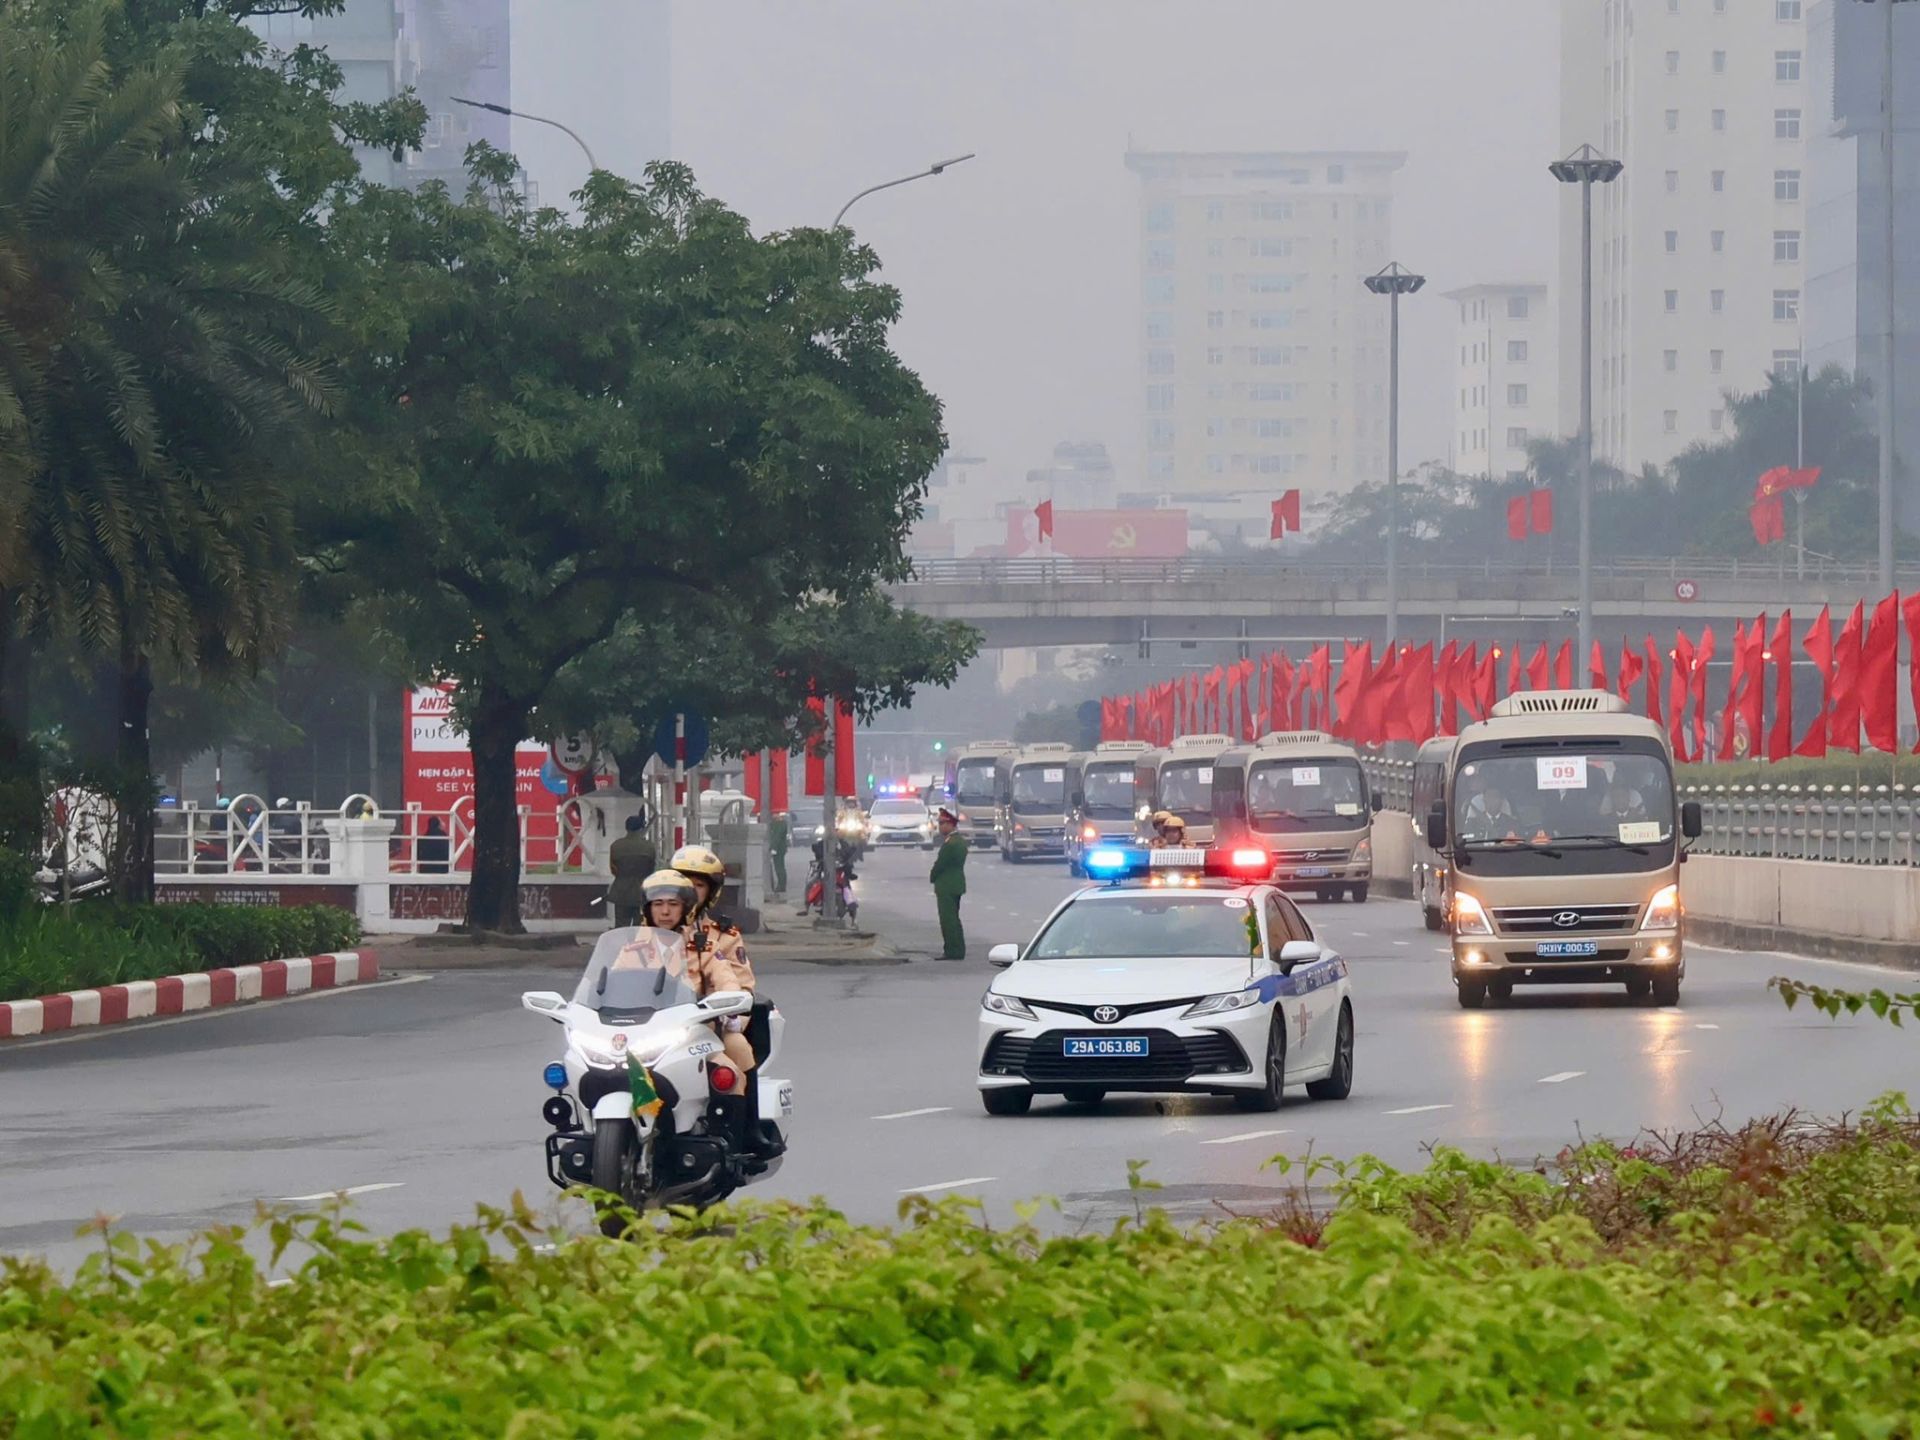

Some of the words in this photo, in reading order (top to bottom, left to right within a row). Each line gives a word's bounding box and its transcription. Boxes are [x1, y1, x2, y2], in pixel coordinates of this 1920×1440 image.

[1552, 766, 1576, 779] 09
[436, 782, 459, 792] SEE
[688, 1043, 714, 1056] CSGT
[1071, 1040, 1141, 1053] 29A-063.86
